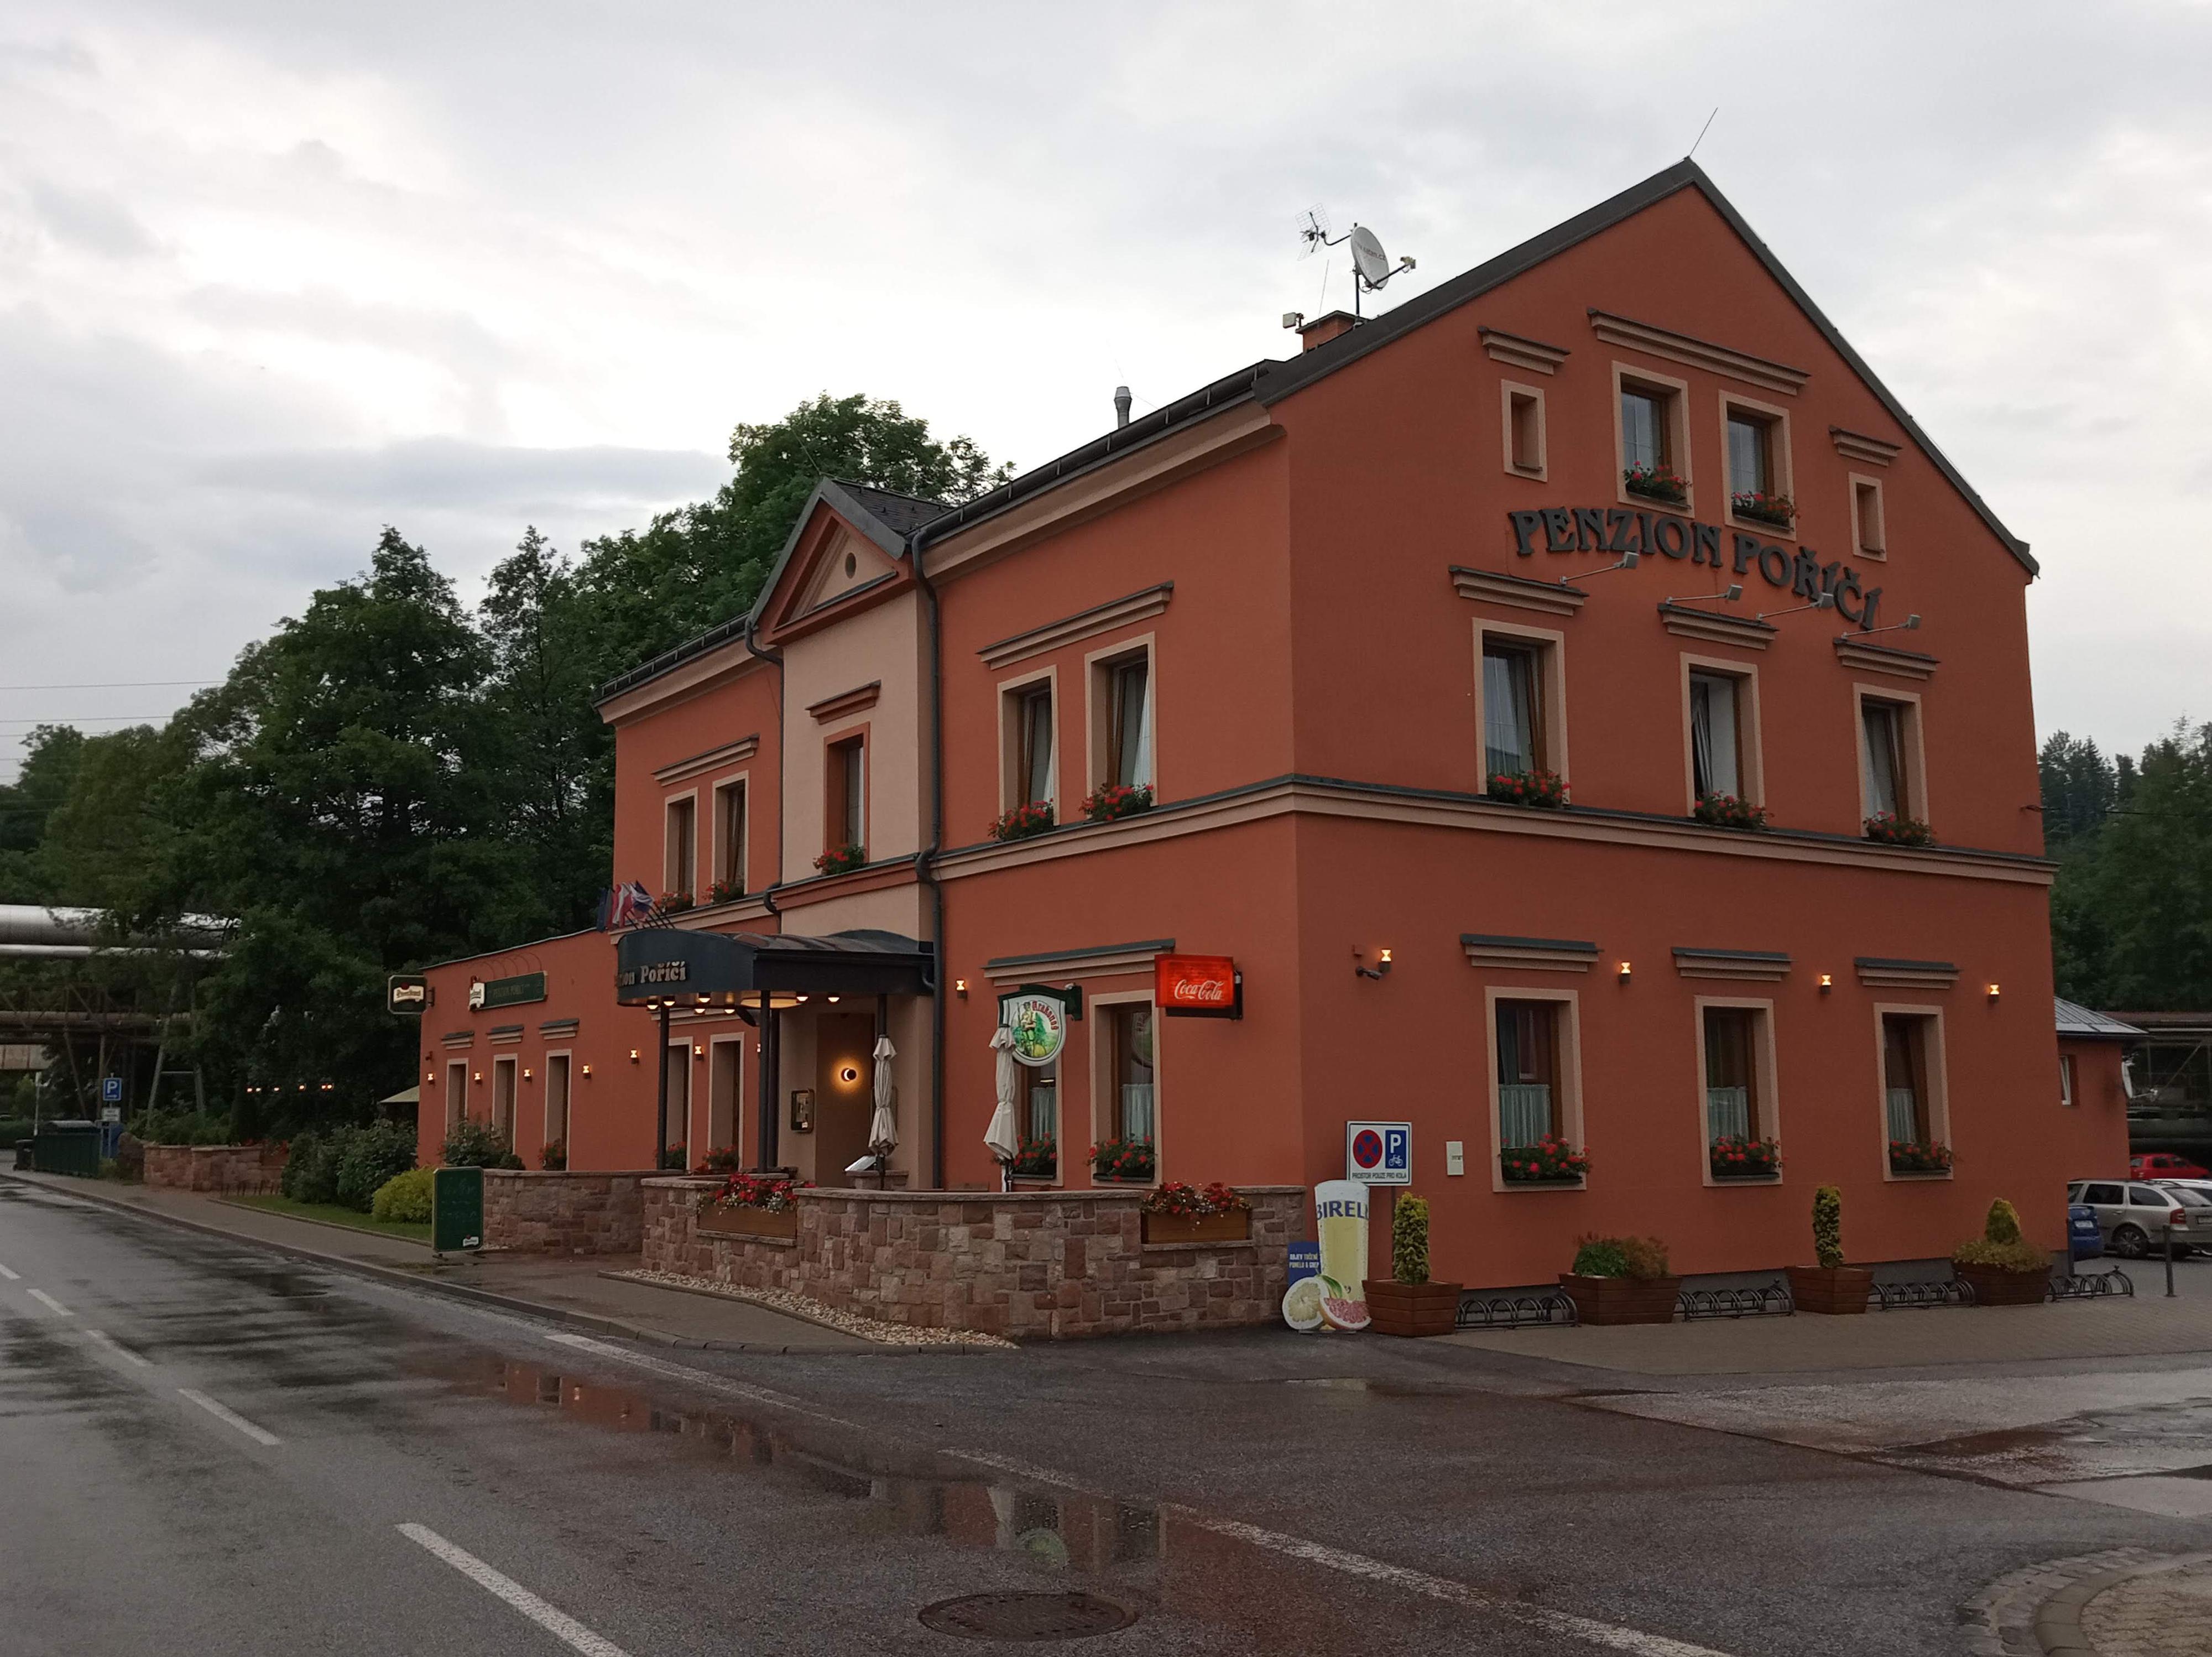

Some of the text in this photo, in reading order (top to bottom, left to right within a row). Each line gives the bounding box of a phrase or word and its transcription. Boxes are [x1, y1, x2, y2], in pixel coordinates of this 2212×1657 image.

[1508, 507, 1884, 630] PENZION POŘÍČÍ
[640, 961, 686, 983] Poříčí
[107, 1081, 118, 1094] P
[1390, 1134, 1402, 1153] P
